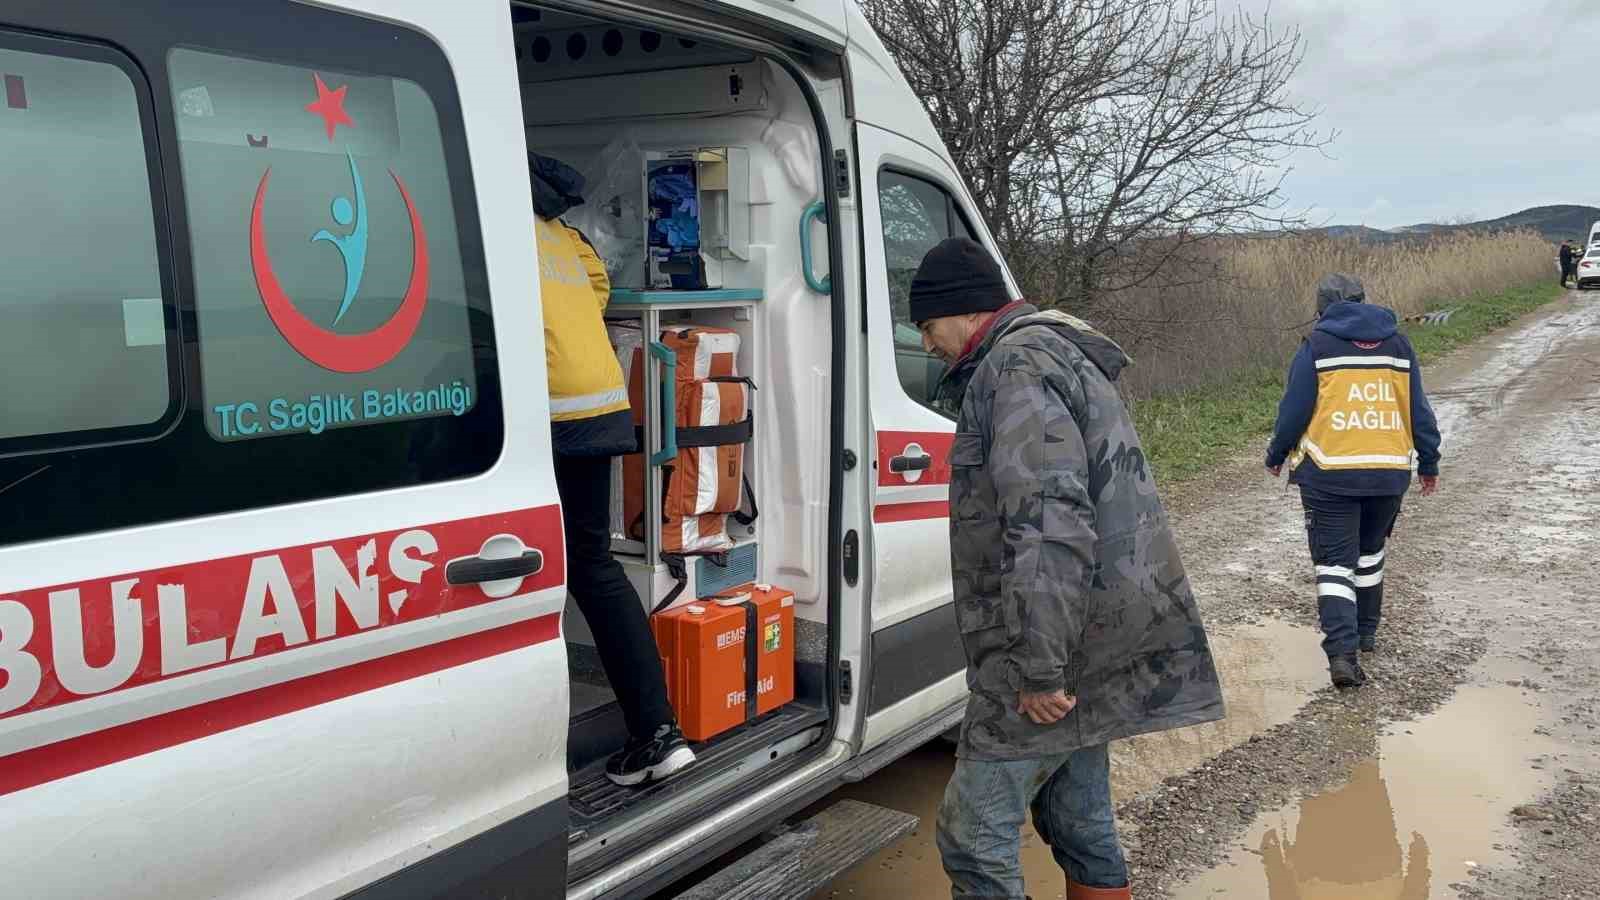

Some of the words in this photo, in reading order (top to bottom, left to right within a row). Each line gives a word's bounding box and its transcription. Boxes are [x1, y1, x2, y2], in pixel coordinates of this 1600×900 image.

[1347, 377, 1396, 402] ACİL
[214, 402, 263, 436] T.C.
[269, 395, 355, 434] Sağlık
[363, 381, 472, 416] Bakanlığı
[727, 690, 746, 708] Firs
[757, 675, 774, 696] Aid
